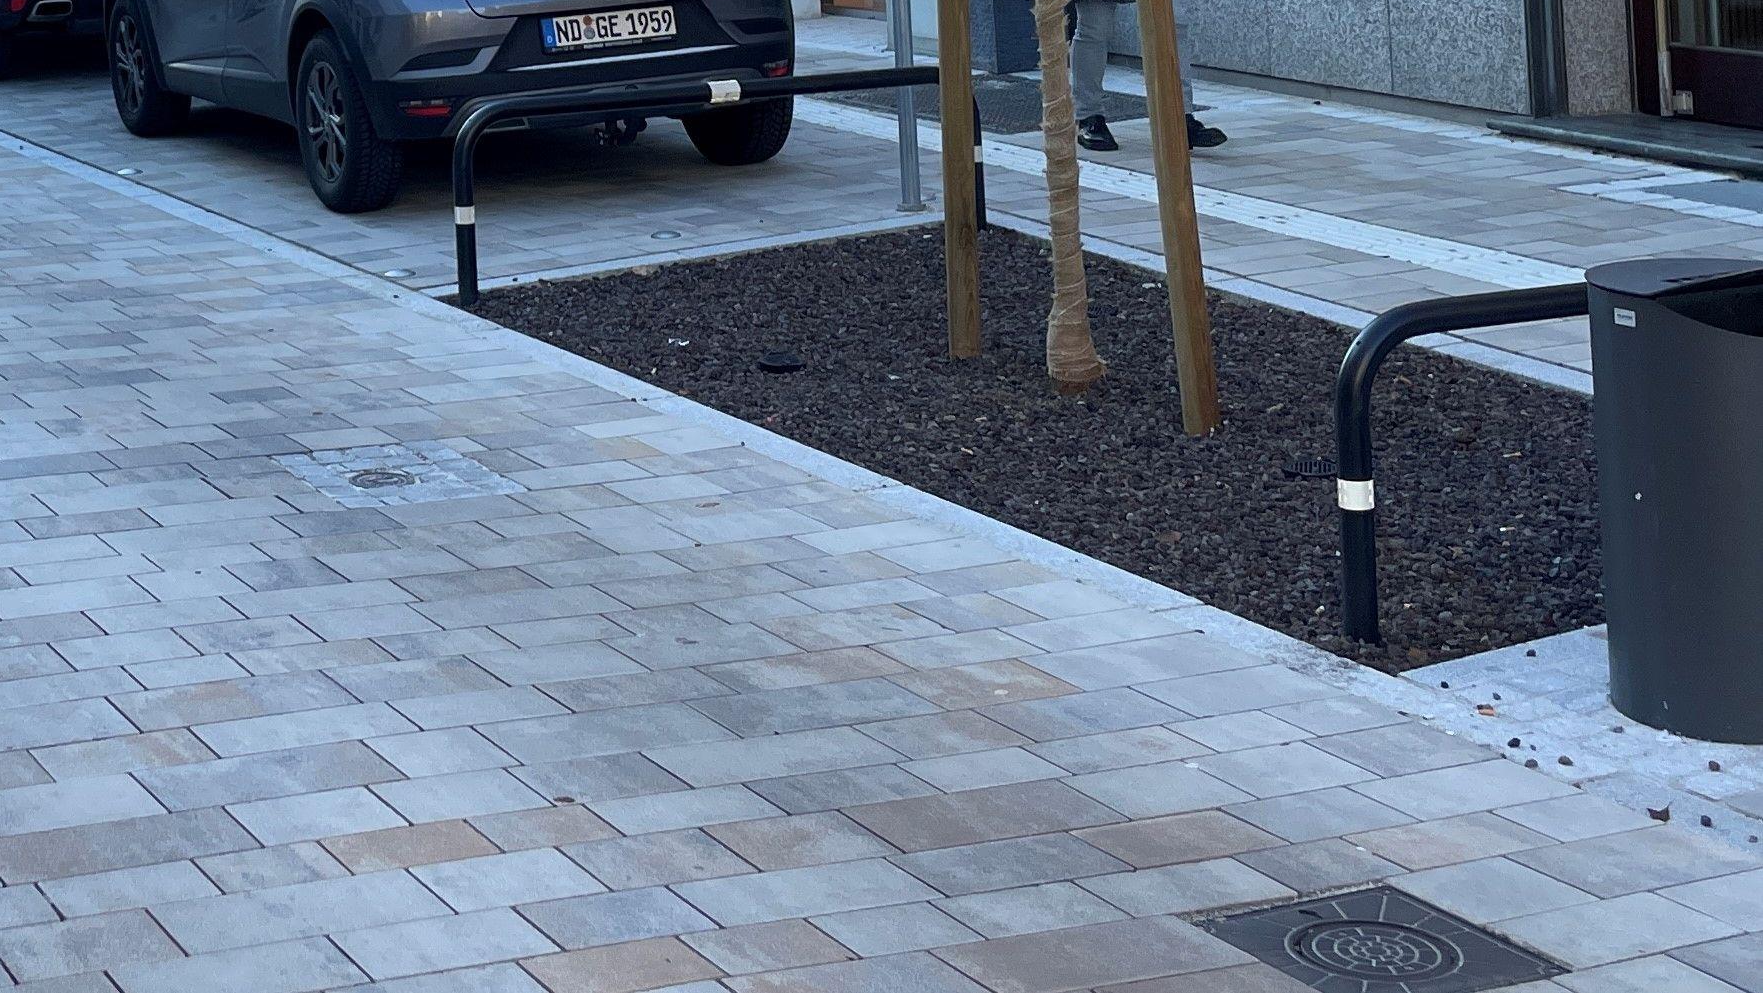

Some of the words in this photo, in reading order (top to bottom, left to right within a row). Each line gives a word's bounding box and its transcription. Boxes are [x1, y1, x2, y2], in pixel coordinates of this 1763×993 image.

[556, 18, 583, 44] ND
[596, 14, 622, 40] GE
[625, 9, 673, 36] 1959
